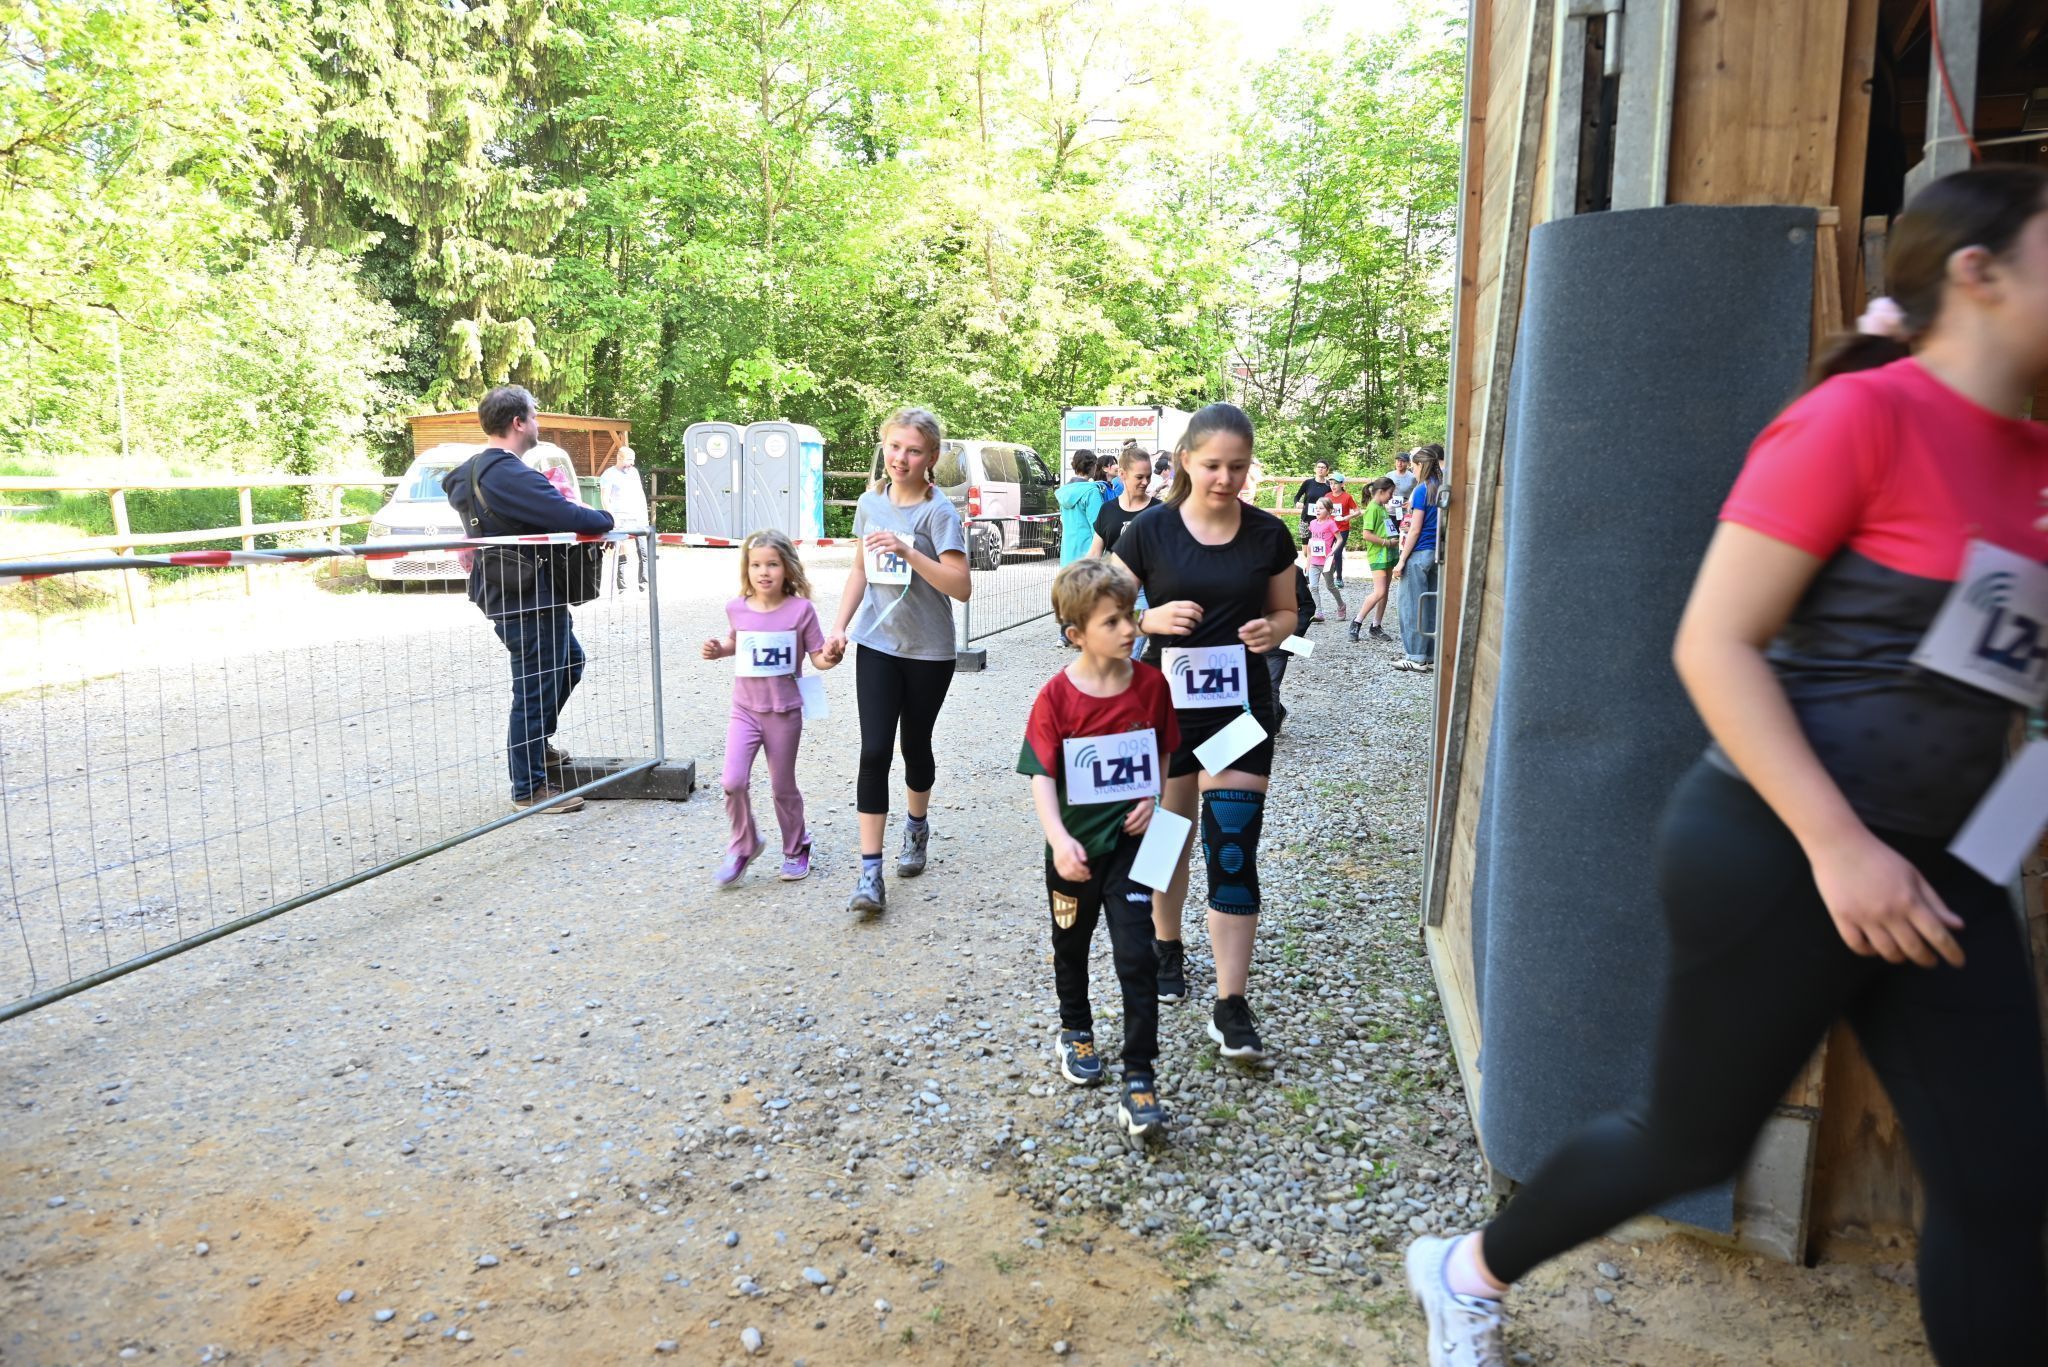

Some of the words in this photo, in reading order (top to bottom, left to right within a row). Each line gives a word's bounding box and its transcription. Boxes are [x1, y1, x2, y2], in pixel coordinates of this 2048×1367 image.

[1099, 415, 1155, 427] Bischof
[876, 553, 907, 573] LZH
[752, 646, 792, 666] LZH
[1208, 653, 1238, 669] 004
[1186, 667, 1240, 694] LZH
[1187, 691, 1240, 702] STUNDENLAUF
[1118, 737, 1150, 759] 098
[1092, 753, 1152, 788] LZH
[1094, 781, 1152, 796] STUNDENLAUF
